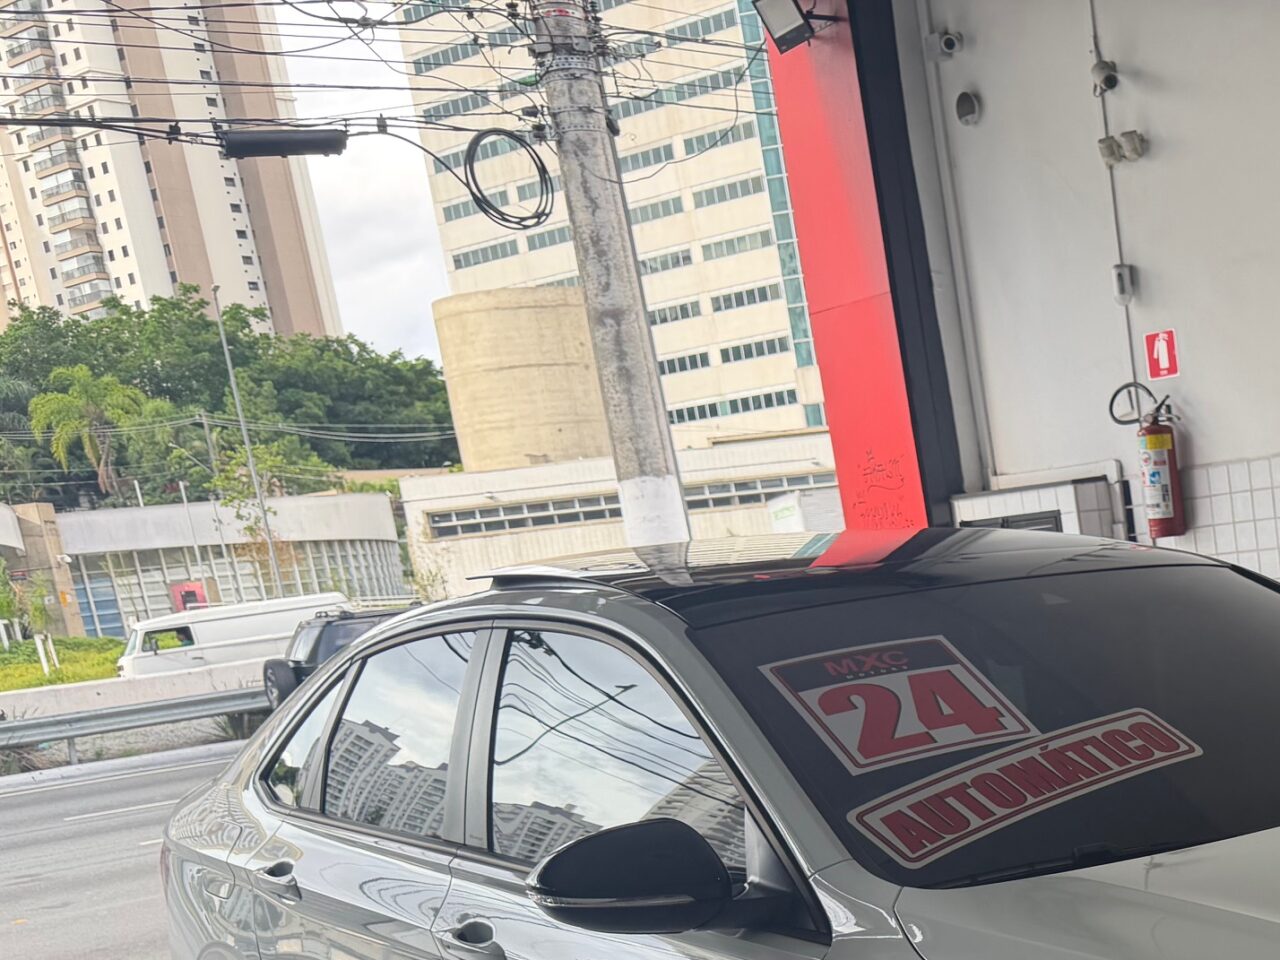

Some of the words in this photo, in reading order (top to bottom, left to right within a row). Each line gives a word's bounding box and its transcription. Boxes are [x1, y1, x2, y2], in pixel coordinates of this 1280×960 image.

[824, 650, 909, 677] MXC
[817, 669, 1007, 760] 24
[879, 721, 1182, 855] AUTOMÁTICO
